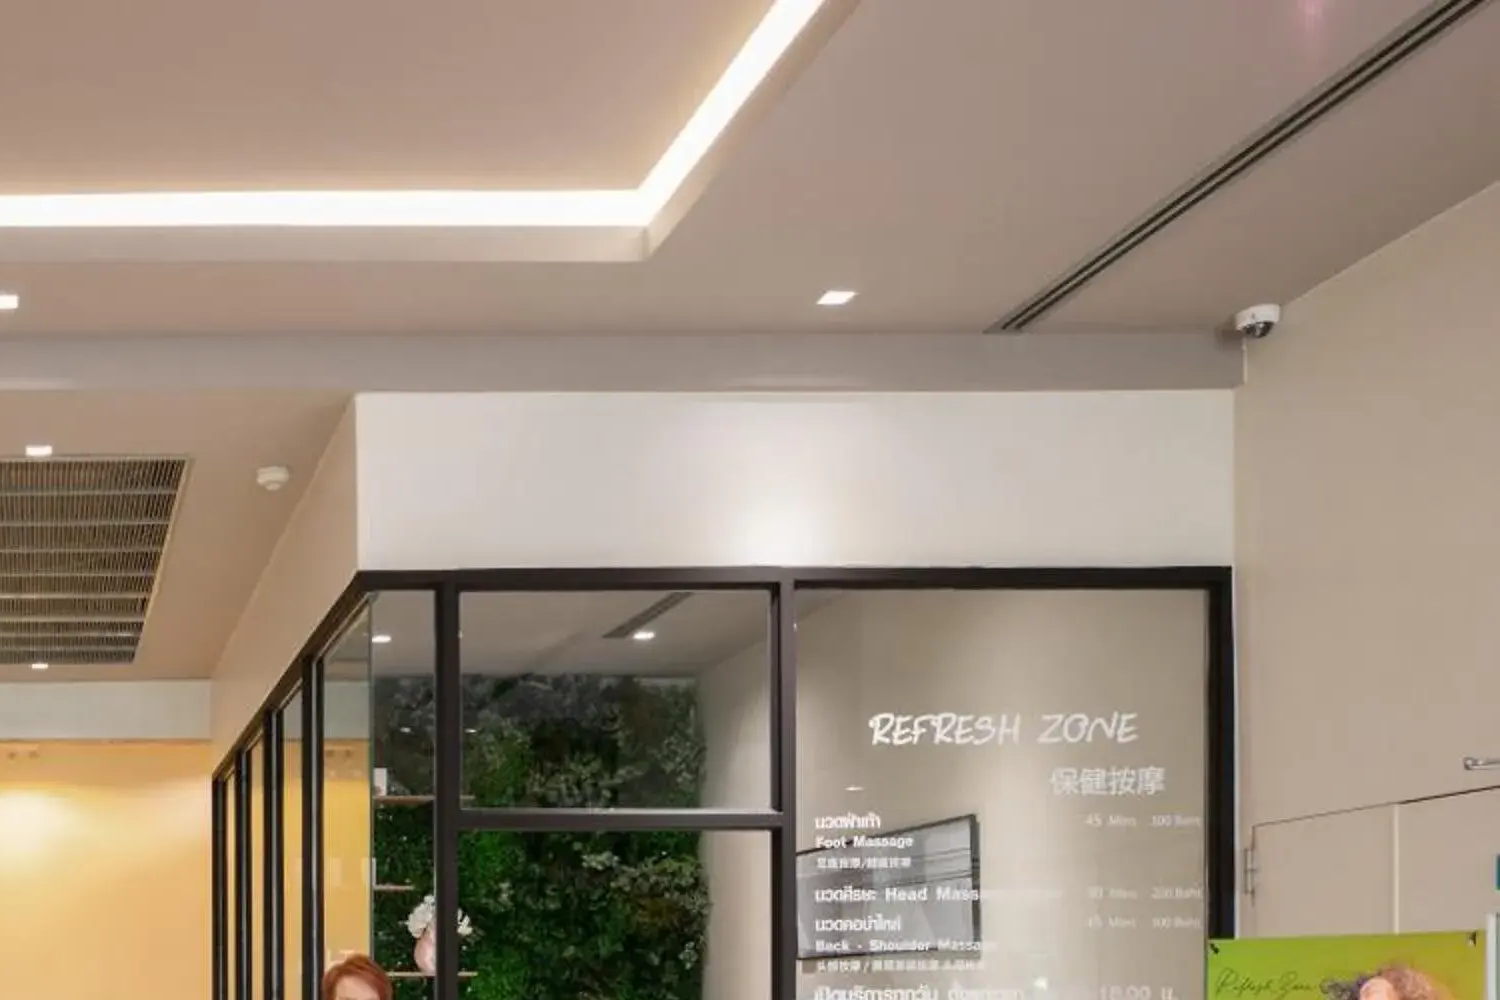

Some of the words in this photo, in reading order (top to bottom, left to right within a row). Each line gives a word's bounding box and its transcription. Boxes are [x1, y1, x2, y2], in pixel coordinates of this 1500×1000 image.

[867, 712, 1020, 746] REFRESH
[1036, 711, 1140, 744] ZONE
[1049, 766, 1166, 796] 保健按摩
[815, 835, 846, 849] Foot
[853, 835, 914, 850] Massage
[884, 886, 928, 902] Head
